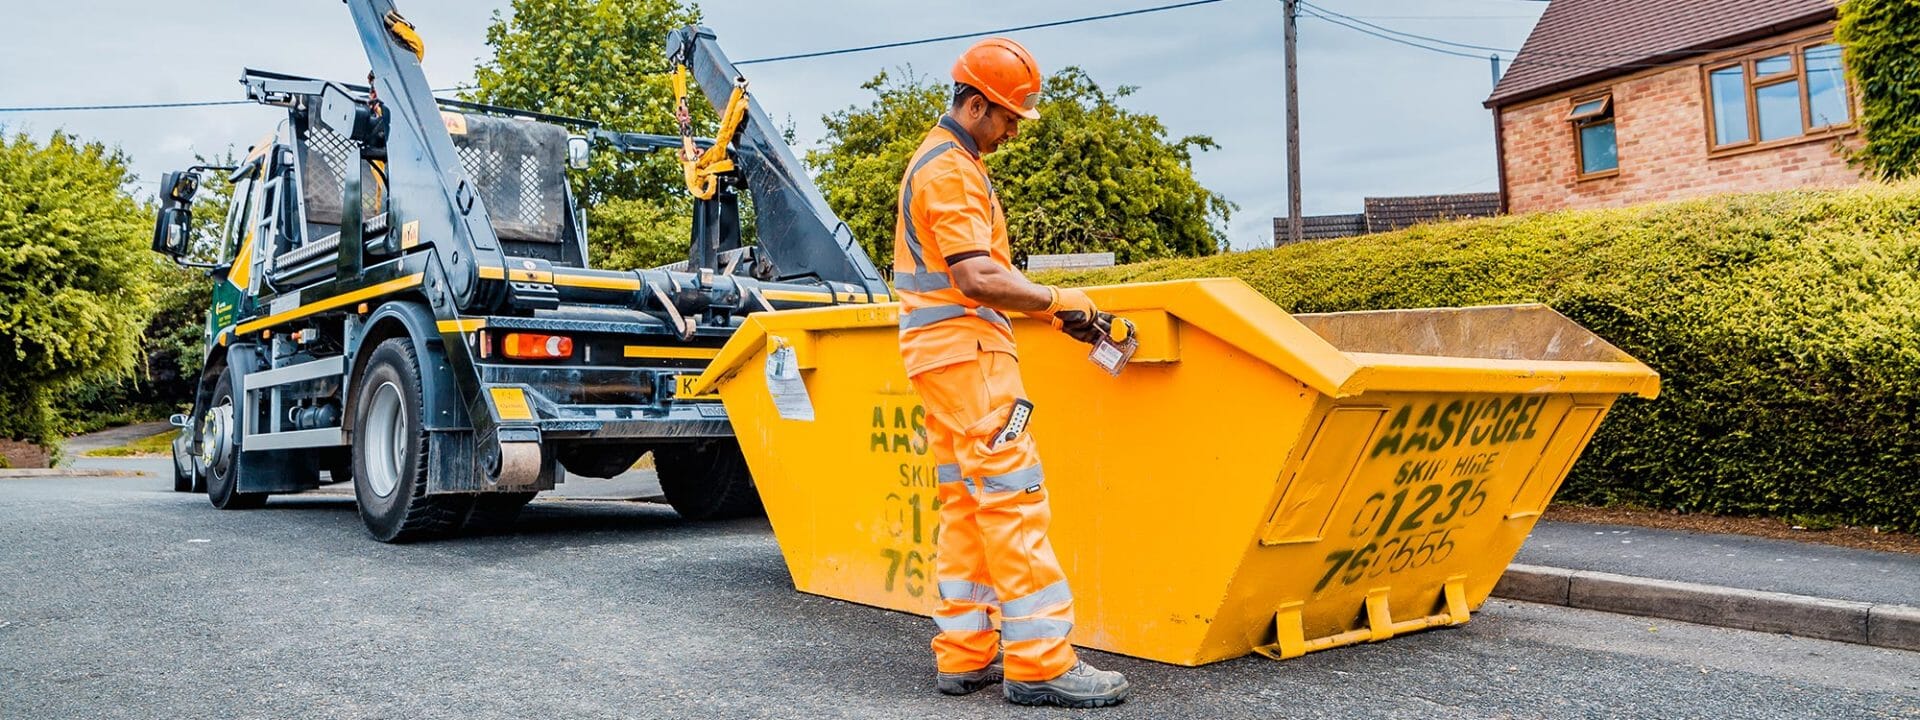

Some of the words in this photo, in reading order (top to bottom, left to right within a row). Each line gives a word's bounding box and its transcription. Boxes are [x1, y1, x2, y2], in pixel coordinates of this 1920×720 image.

[683, 378, 698, 395] K
[1371, 393, 1549, 459] AASVOGEL
[1394, 459, 1448, 486] SKIP
[1451, 452, 1500, 477] HIRE
[1351, 478, 1489, 538] 01235
[1313, 526, 1464, 593] 760555
